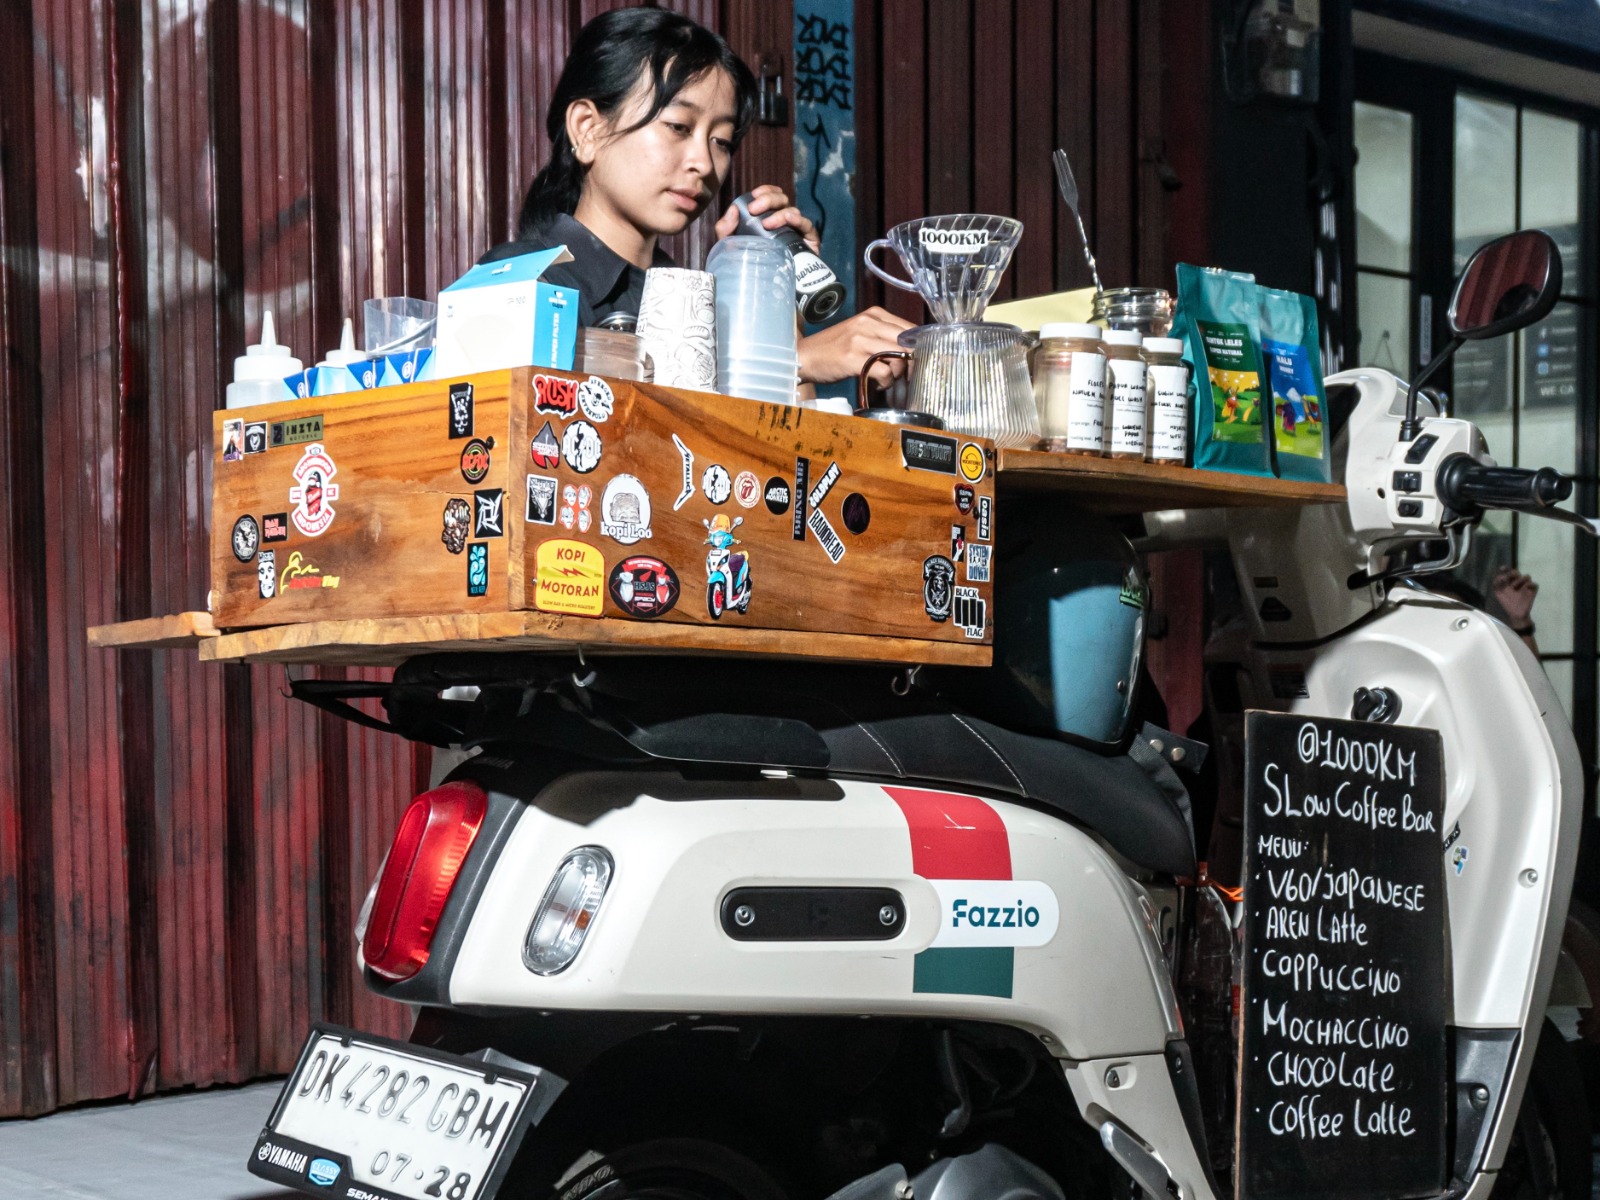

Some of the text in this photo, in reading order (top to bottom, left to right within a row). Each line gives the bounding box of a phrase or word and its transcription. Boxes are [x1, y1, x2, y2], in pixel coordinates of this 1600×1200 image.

[921, 230, 987, 246] 1000KM
[534, 376, 578, 413] RUSH
[1540, 385, 1557, 396] WE
[765, 493, 789, 504] MONKEYS
[768, 486, 788, 497] ARCTIC
[808, 463, 841, 509] COLDPLAY
[981, 499, 989, 538] oasis
[808, 511, 844, 563] RADIOHEAD
[968, 544, 989, 558] SYSTEM
[556, 547, 586, 563] KOPI
[540, 578, 600, 597] MOTORAN
[955, 587, 978, 598] BLACK
[966, 627, 983, 637] FLAG
[1298, 722, 1416, 787] @1000KM
[1334, 781, 1398, 830] Coffee
[952, 899, 1040, 928] Fazzio
[1266, 905, 1310, 940] AREN
[298, 1050, 511, 1149] DK 4282 GBM
[1268, 1094, 1344, 1140] Coffee
[267, 1145, 309, 1174] YAMAHA
[312, 1161, 338, 1175] CLASSY
